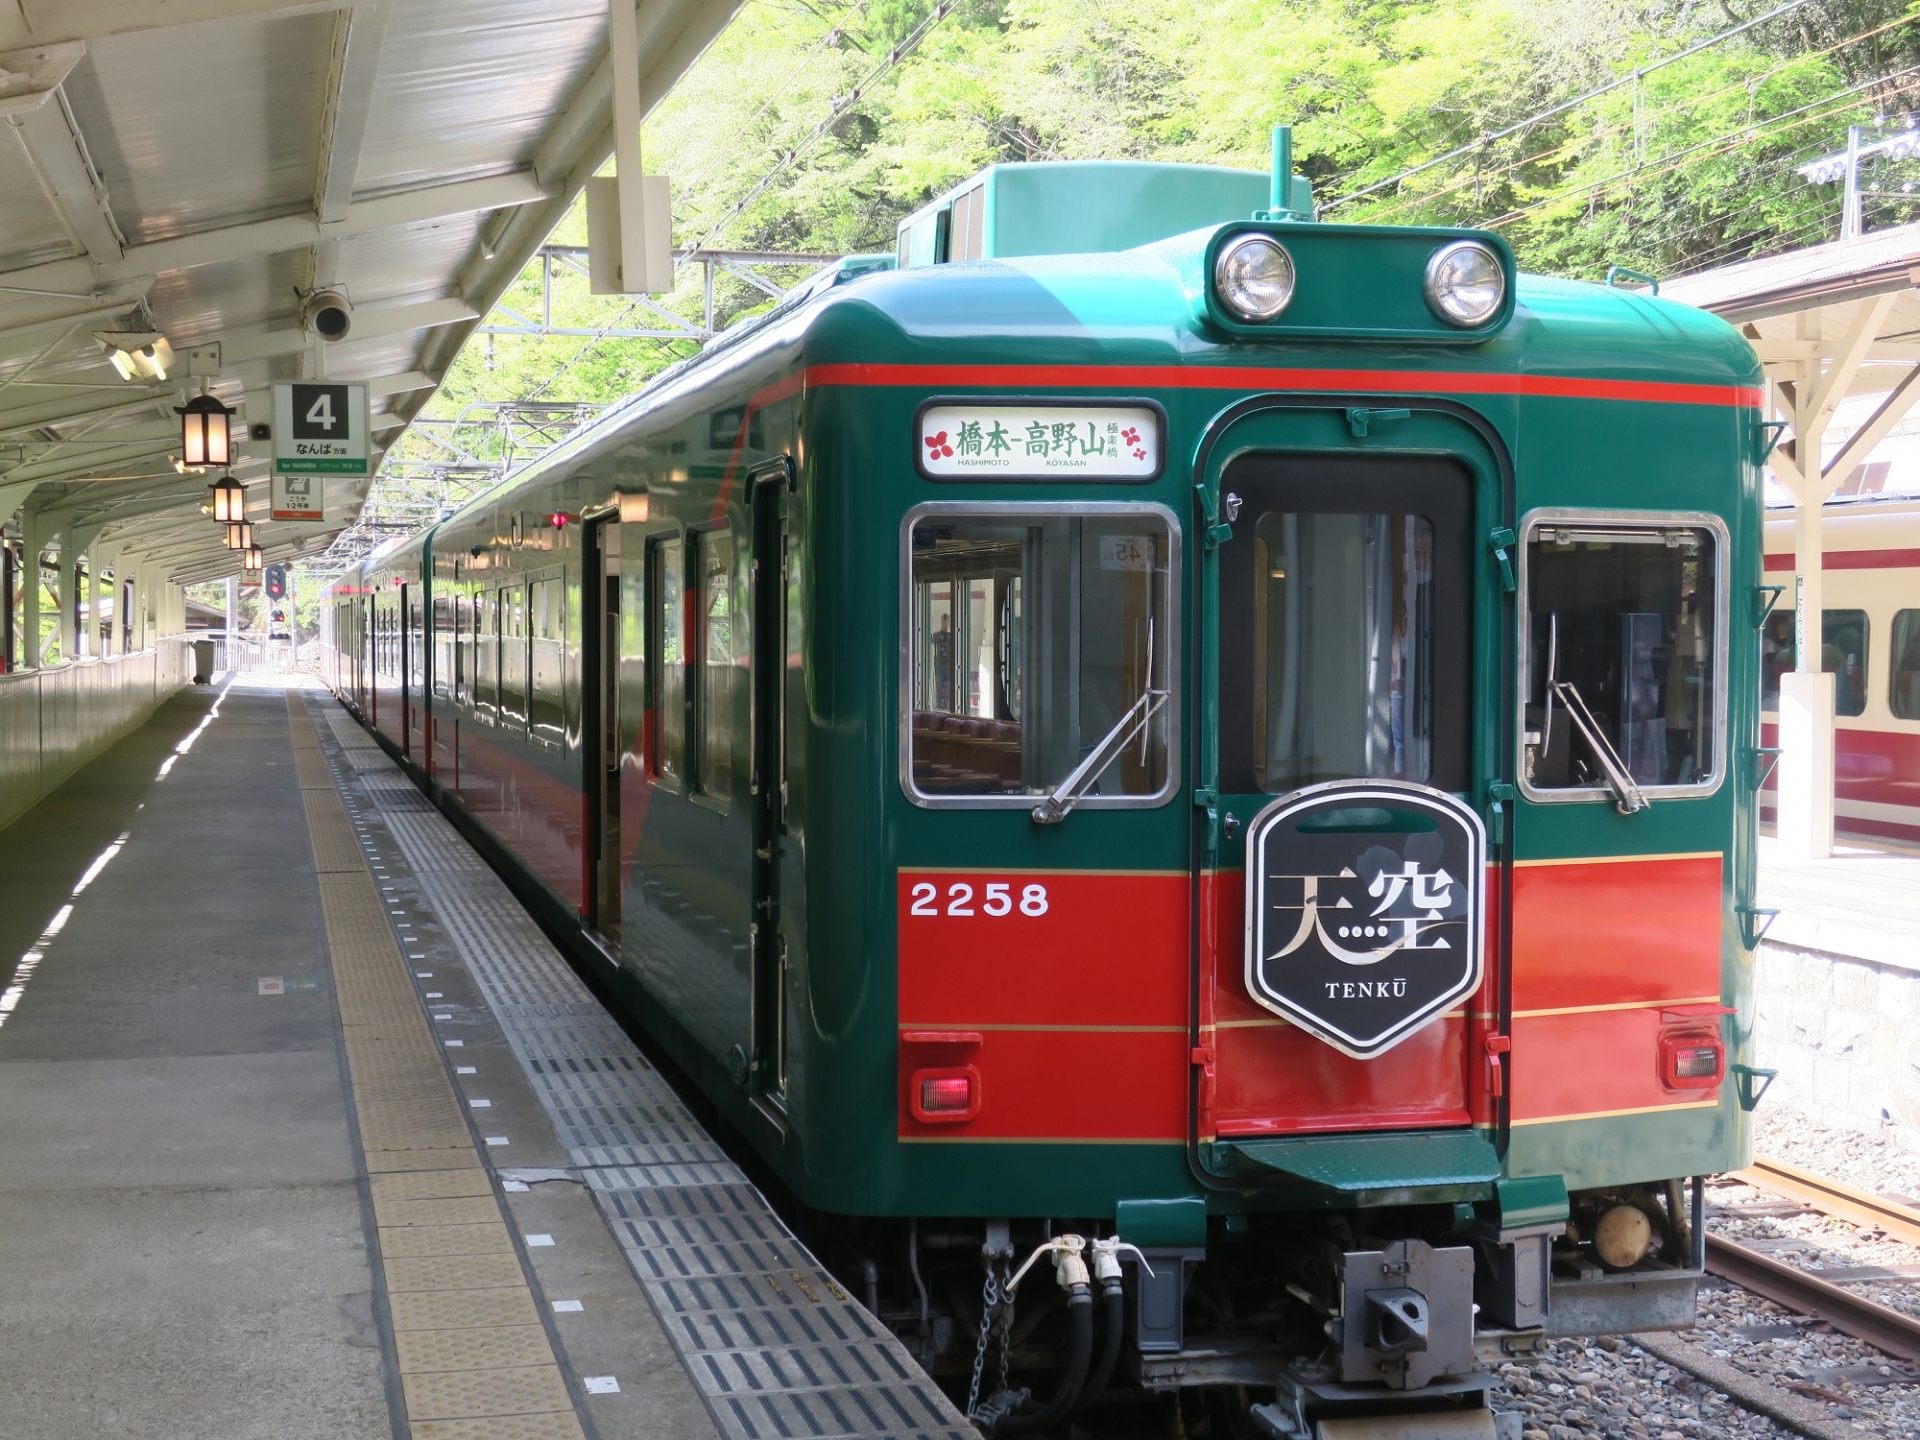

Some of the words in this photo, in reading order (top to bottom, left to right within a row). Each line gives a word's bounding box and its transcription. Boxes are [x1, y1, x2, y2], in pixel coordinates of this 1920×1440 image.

[306, 394, 336, 430] 4
[1106, 422, 1119, 458] 極楽橋
[957, 459, 1010, 467] HASHIMOTO
[911, 882, 1049, 917] 2258
[1266, 861, 1468, 965] 天空
